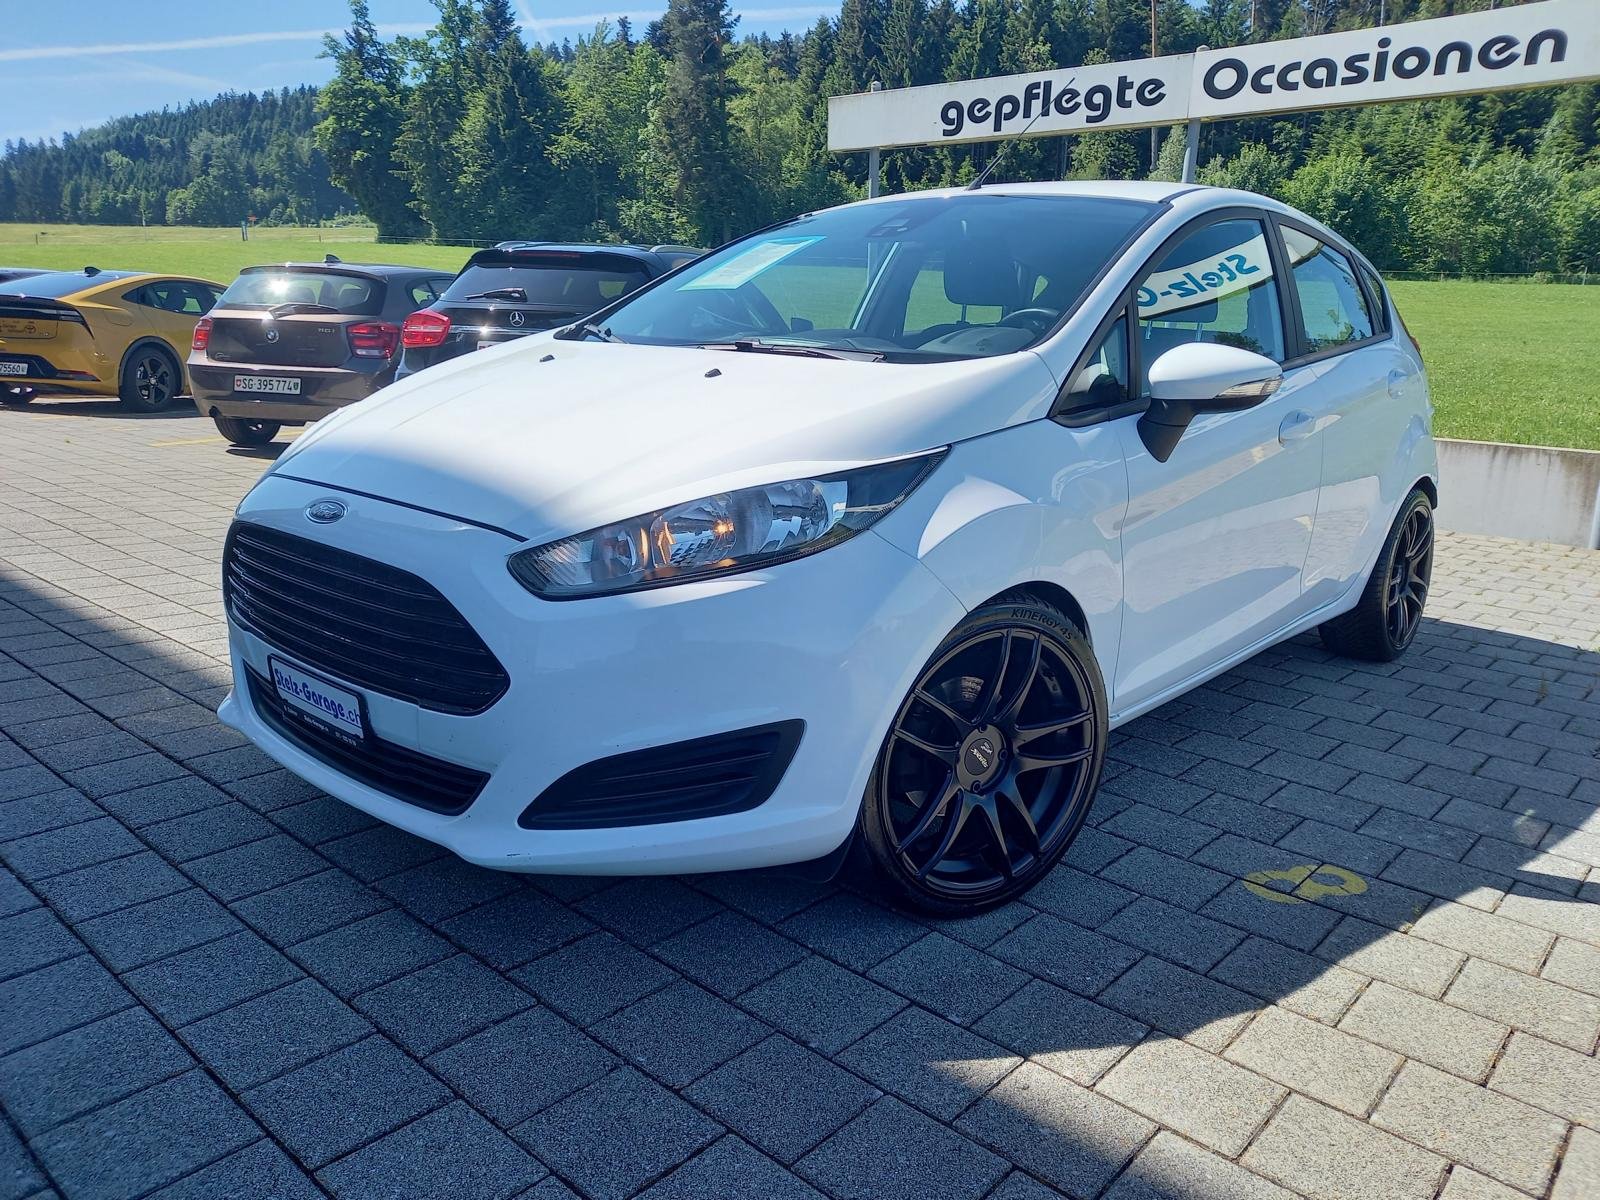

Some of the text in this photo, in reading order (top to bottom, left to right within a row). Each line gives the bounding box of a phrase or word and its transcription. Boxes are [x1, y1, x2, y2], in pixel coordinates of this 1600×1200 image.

[941, 28, 1568, 136] gepflegte Occasionen
[1011, 608, 1061, 630] KINERGY
[274, 668, 361, 724] Stelz-Garage.ch
